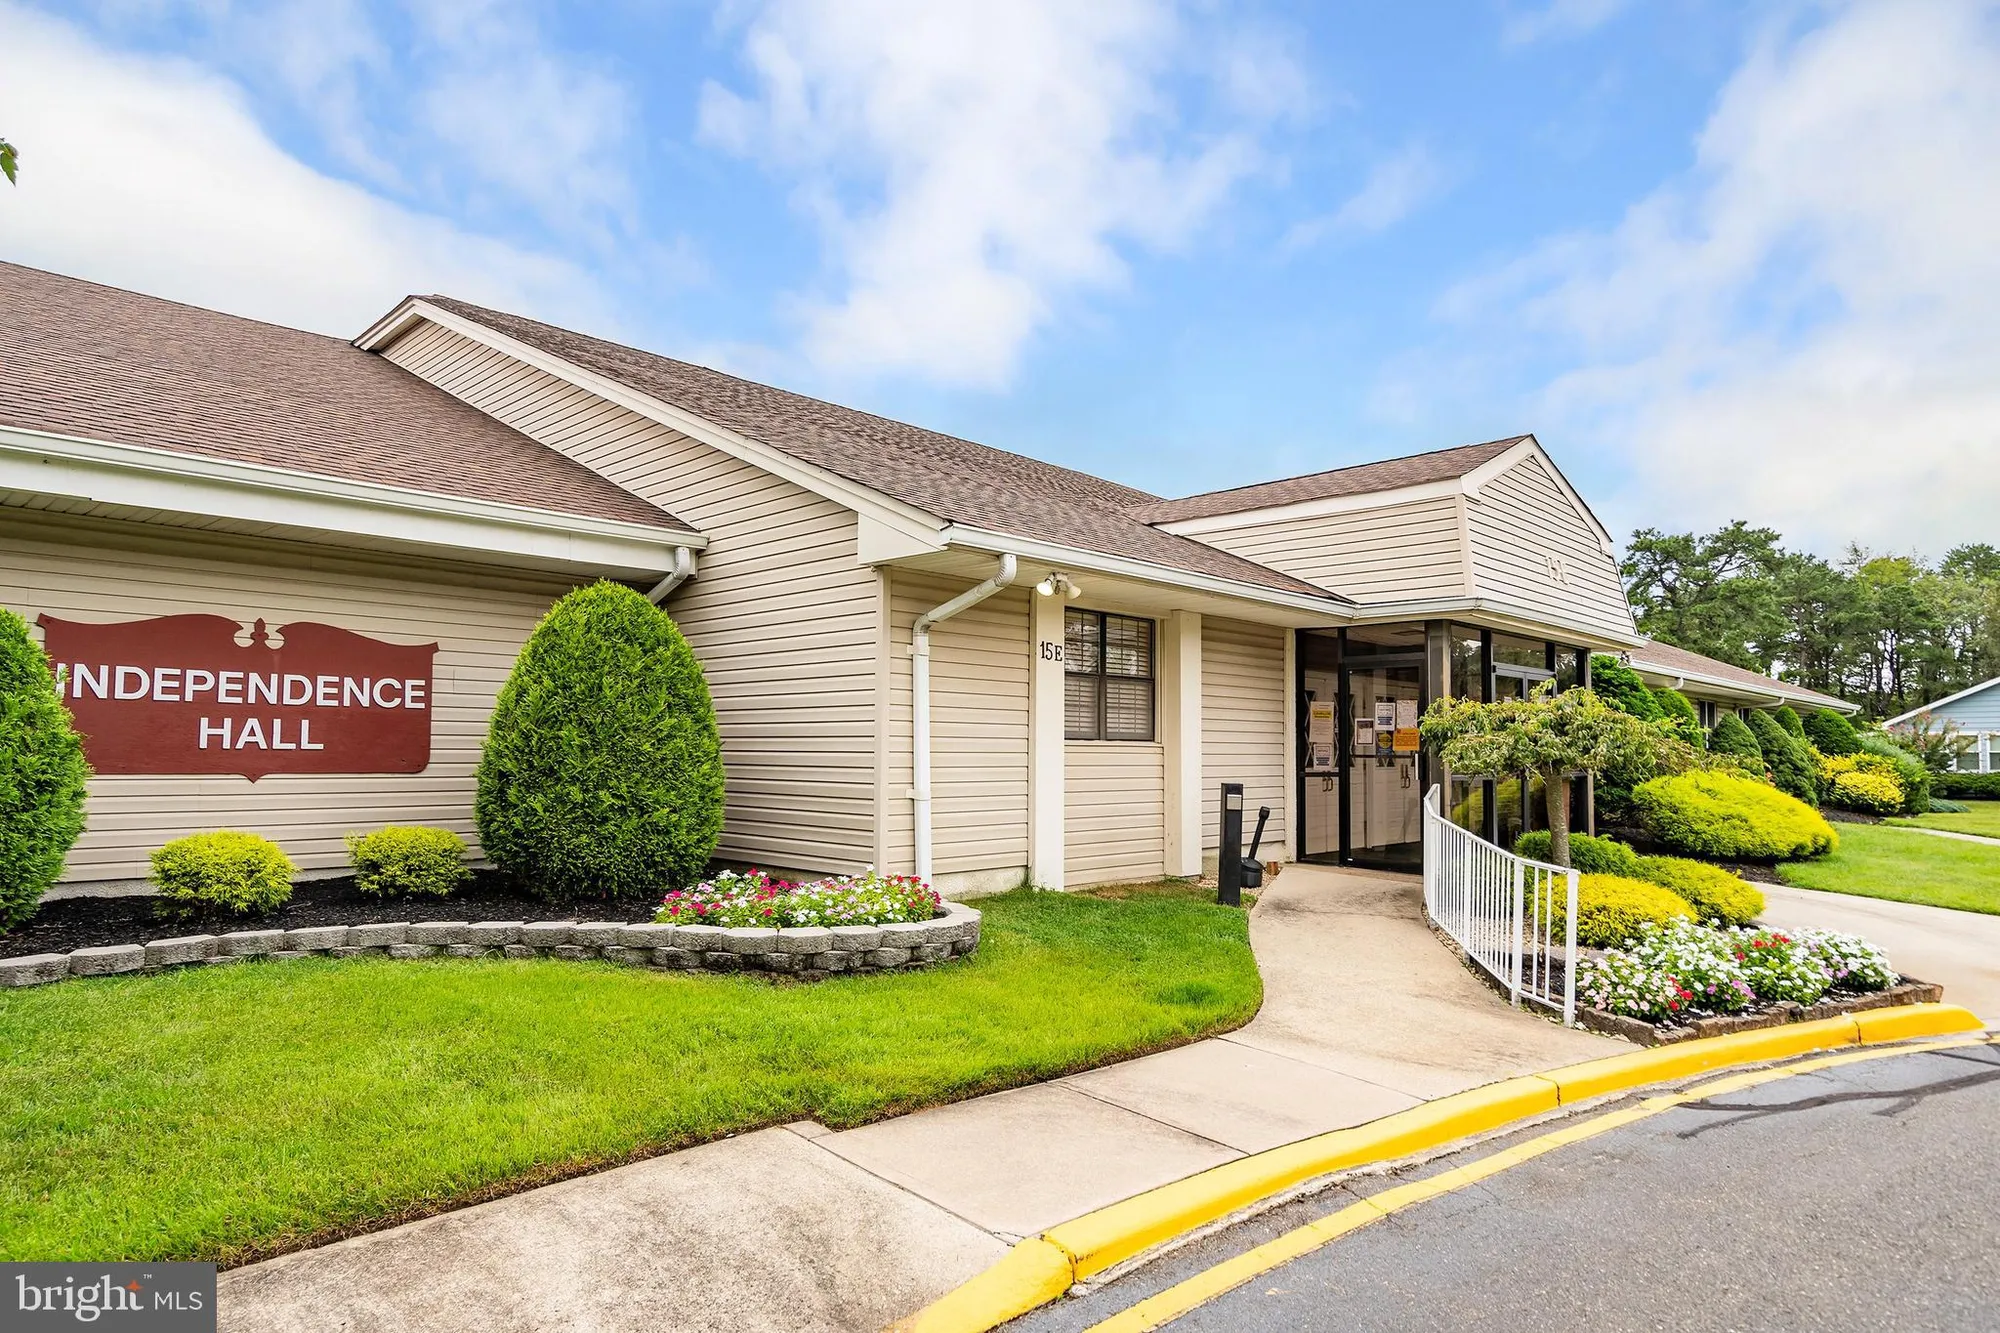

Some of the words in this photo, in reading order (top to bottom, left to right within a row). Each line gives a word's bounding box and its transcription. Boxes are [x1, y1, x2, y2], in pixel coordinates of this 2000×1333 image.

[1039, 640, 1063, 662] 15E
[56, 662, 426, 709] INDEPENDENCE
[199, 717, 324, 750] HALL
